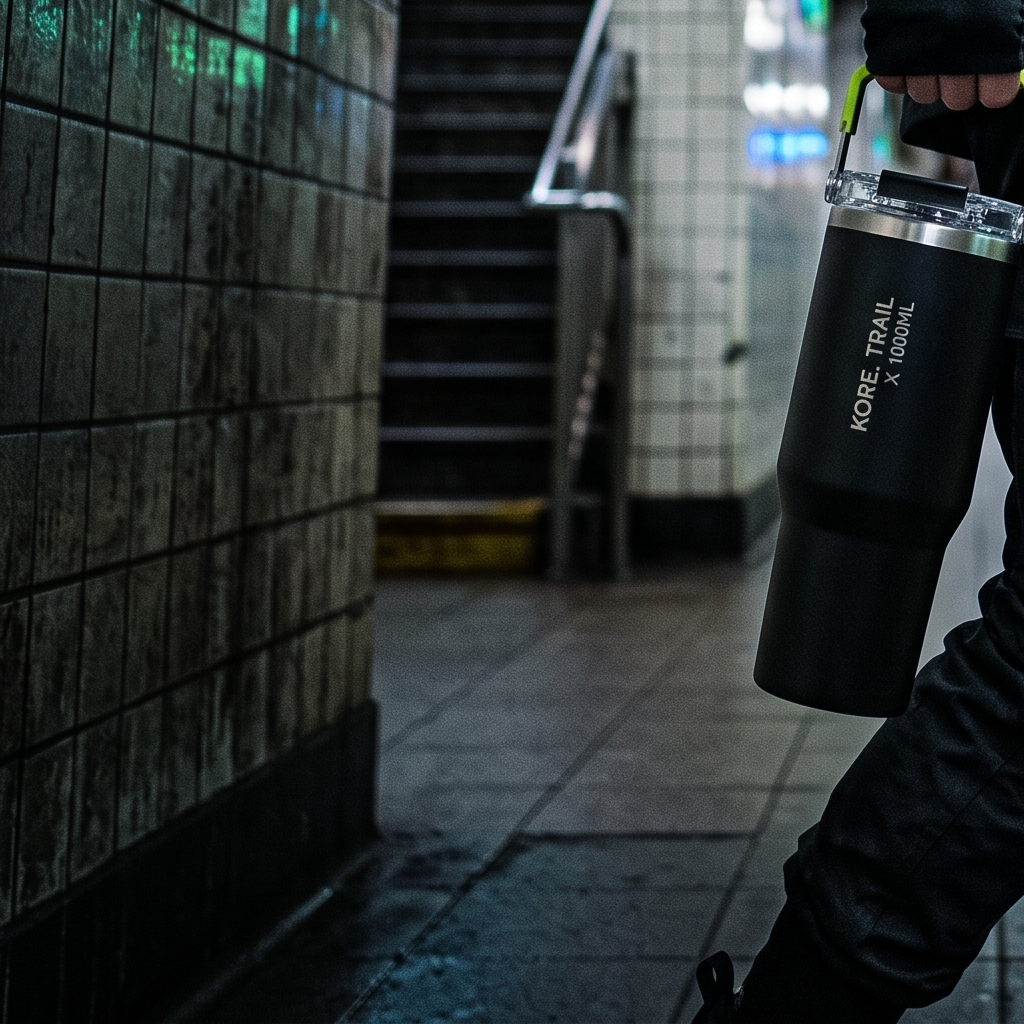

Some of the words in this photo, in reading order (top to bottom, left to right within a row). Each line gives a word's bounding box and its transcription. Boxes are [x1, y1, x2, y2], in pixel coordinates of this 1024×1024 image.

[888, 302, 915, 364] 1000ML
[850, 366, 880, 432] KORE.
[865, 297, 894, 357] TRAIL
[884, 371, 900, 386] X
